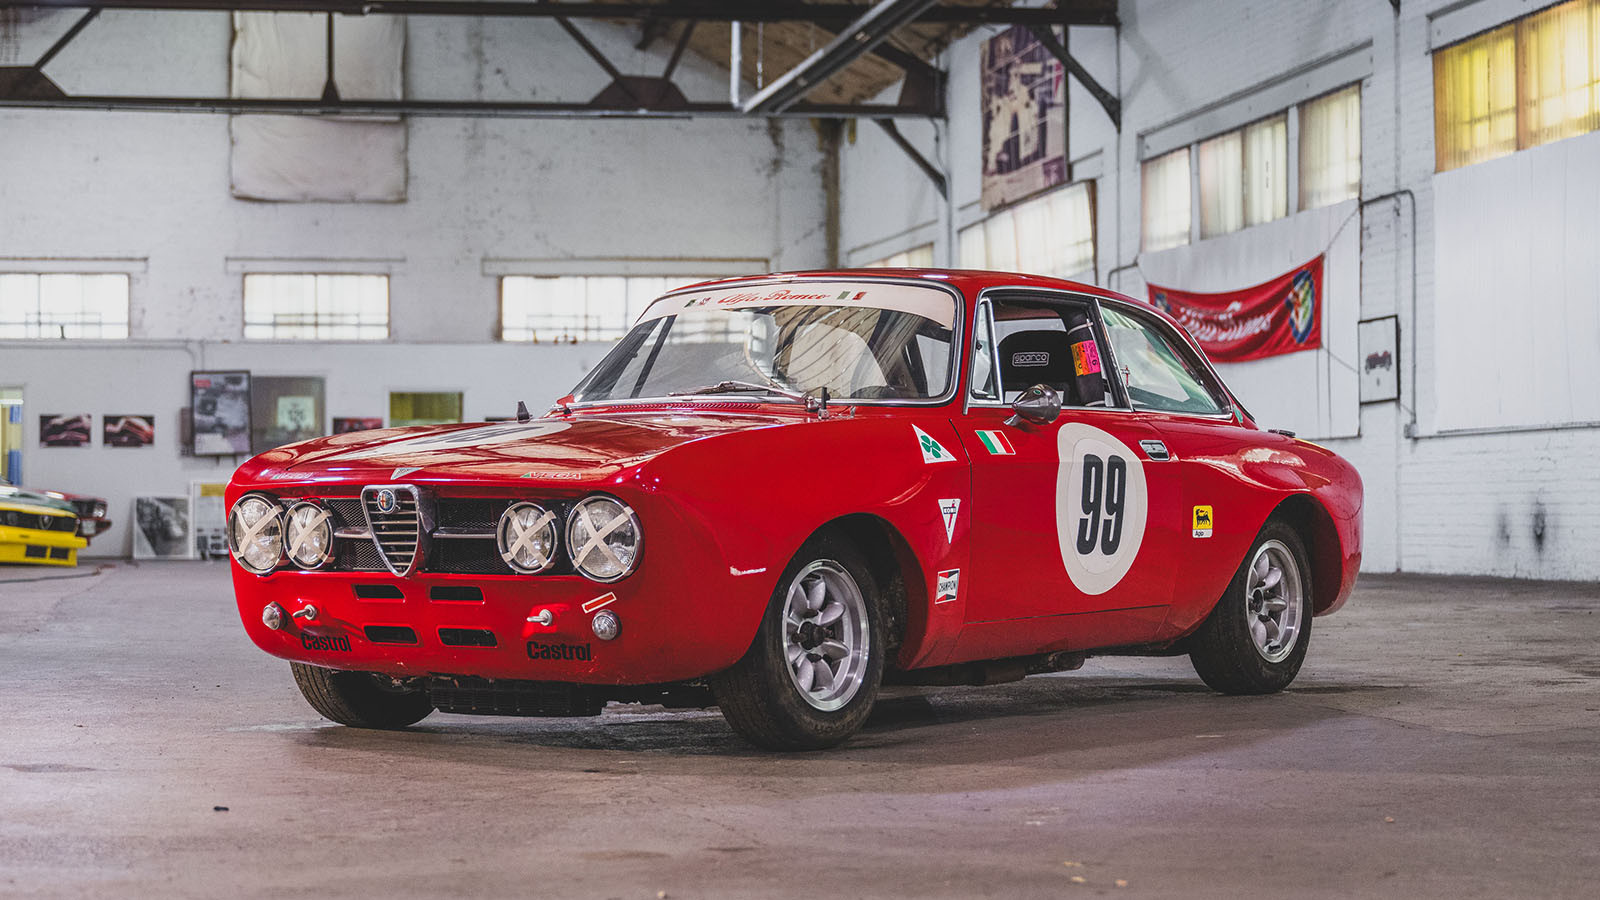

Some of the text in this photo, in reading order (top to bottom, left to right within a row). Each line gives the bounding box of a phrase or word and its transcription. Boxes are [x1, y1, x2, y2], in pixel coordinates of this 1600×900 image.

[763, 289, 829, 302] Romeo
[1015, 354, 1047, 363] sparco
[1076, 453, 1127, 556] 99
[301, 633, 353, 652] Castrol
[526, 640, 592, 661] Castrol
